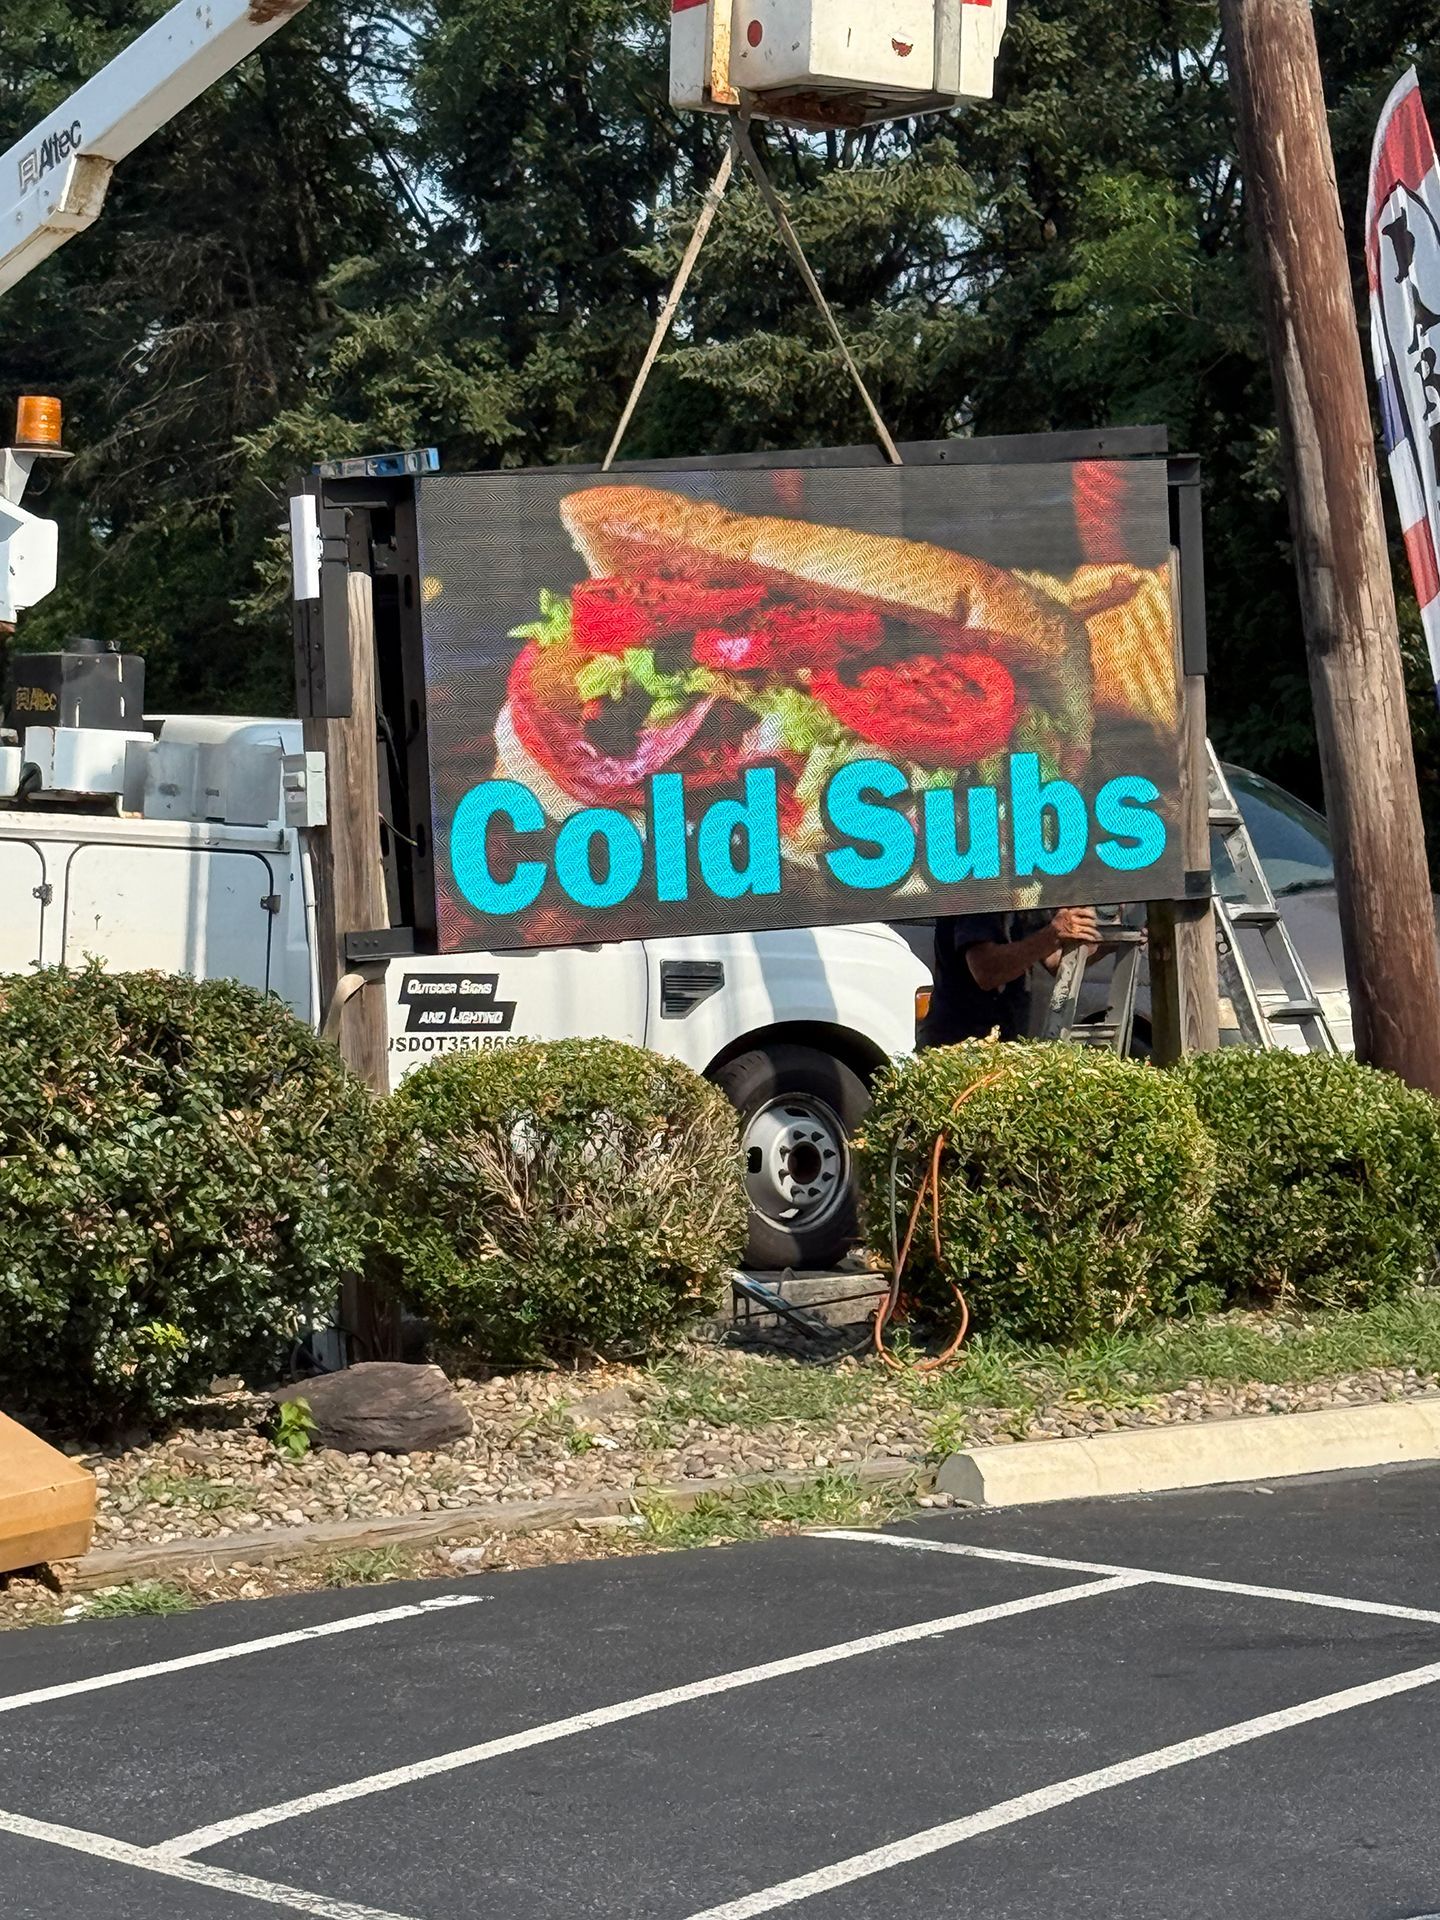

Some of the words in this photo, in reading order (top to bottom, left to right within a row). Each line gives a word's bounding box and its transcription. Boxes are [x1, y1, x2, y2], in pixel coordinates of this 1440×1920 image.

[39, 120, 82, 178] Altec
[450, 767, 782, 915] Cold
[825, 752, 1167, 890] Subs
